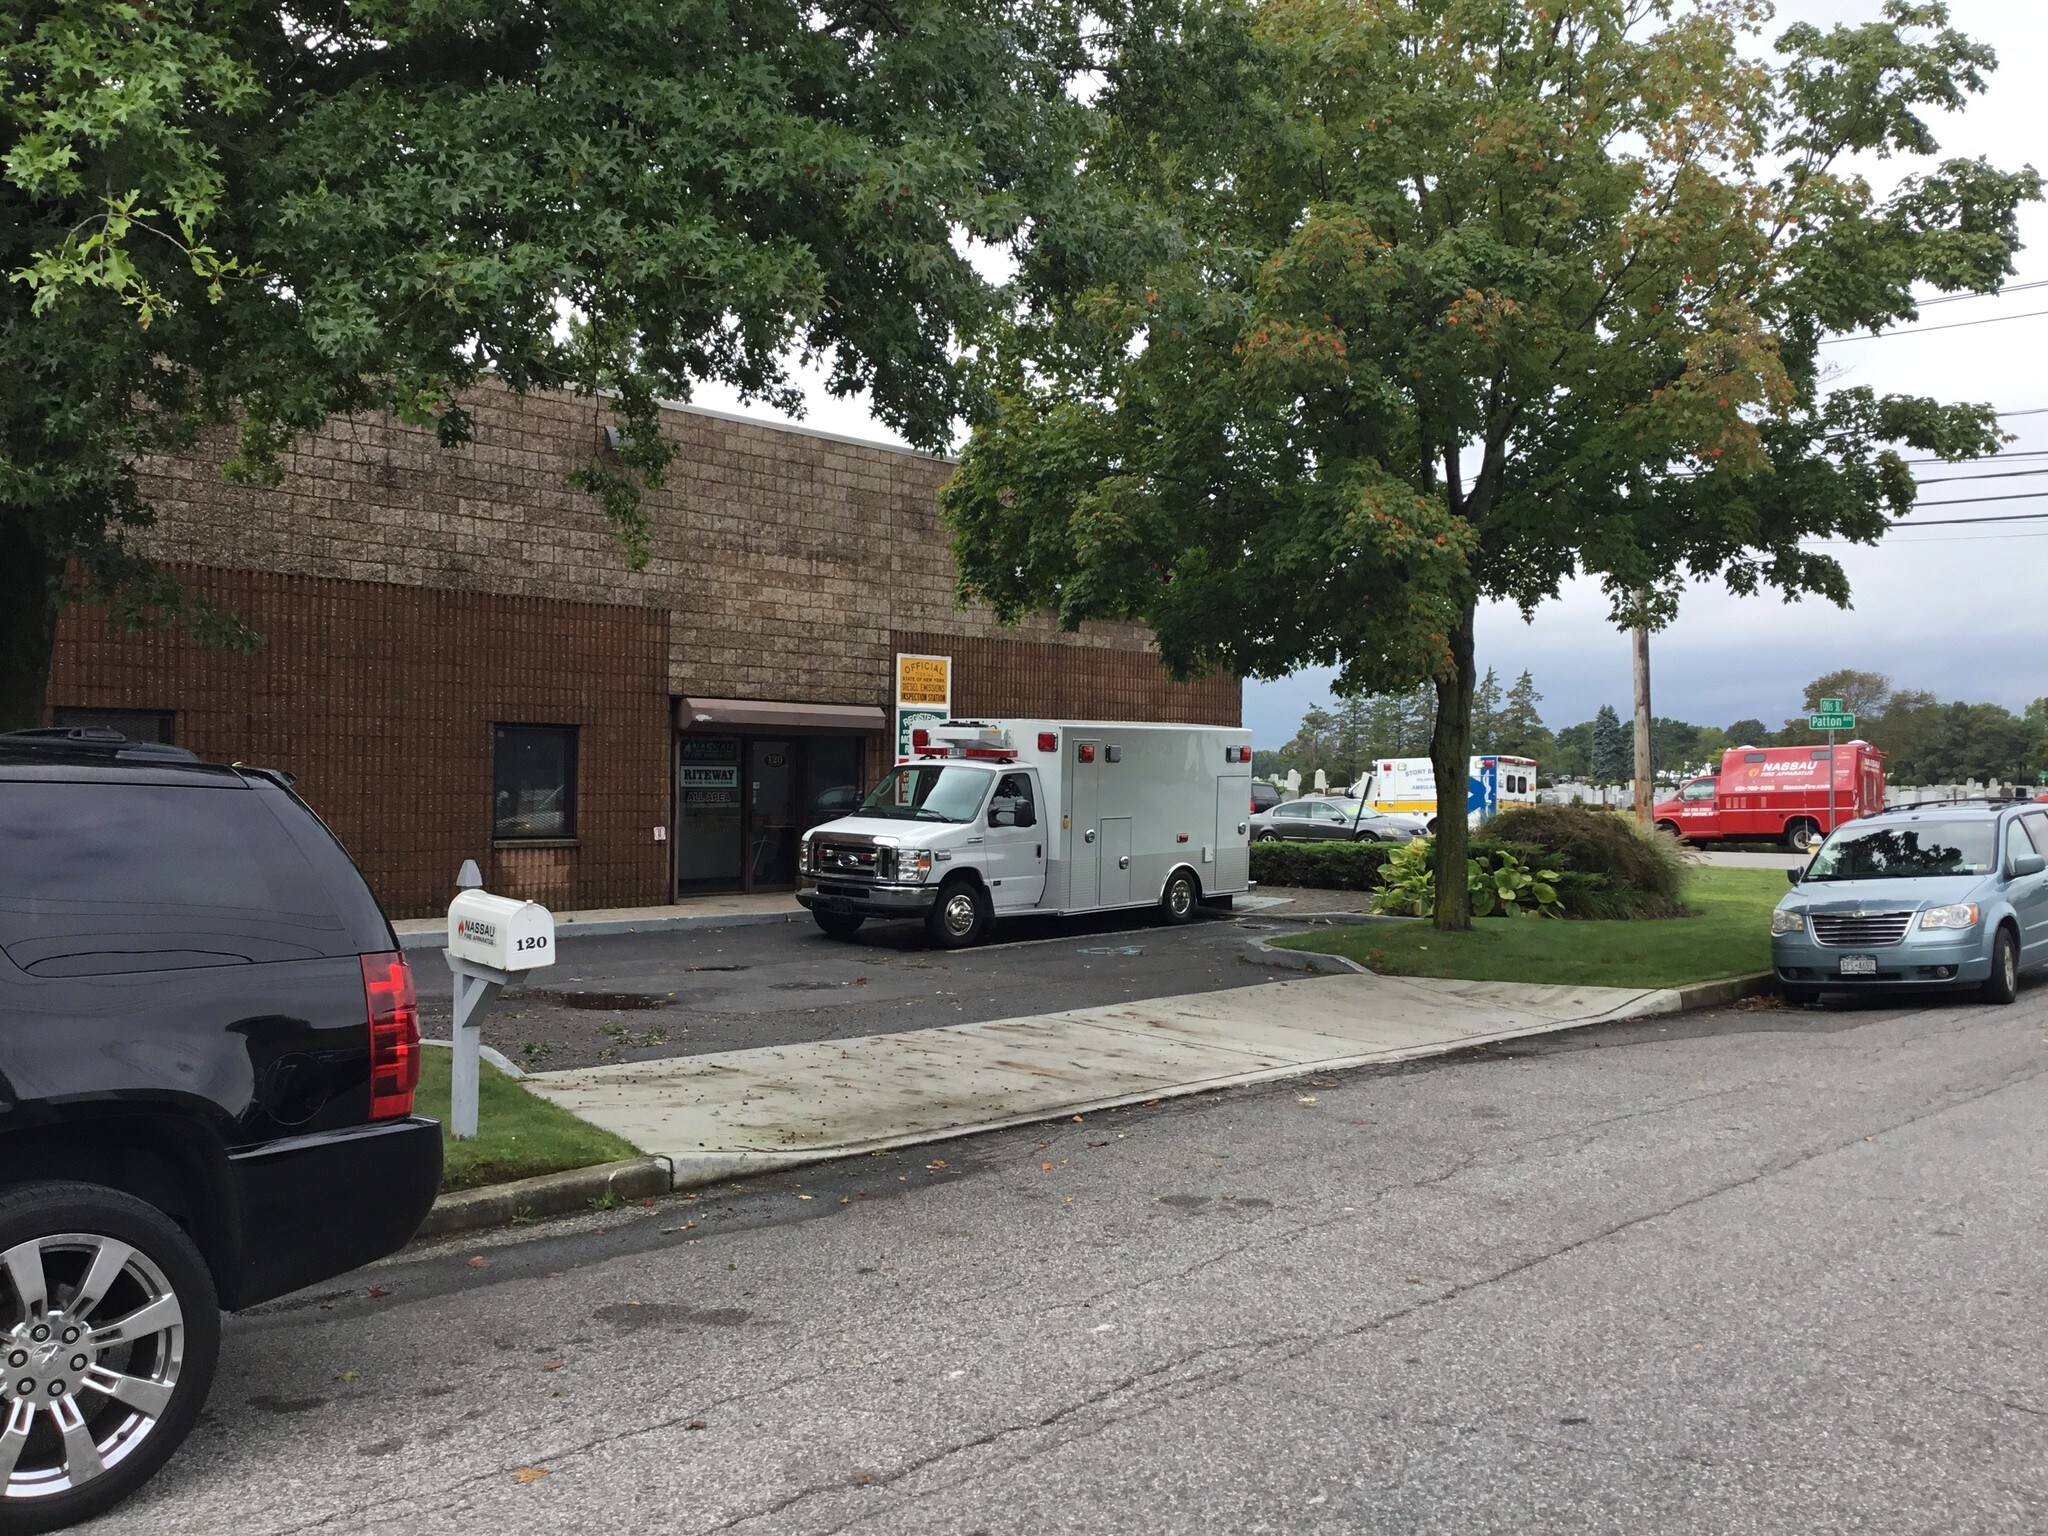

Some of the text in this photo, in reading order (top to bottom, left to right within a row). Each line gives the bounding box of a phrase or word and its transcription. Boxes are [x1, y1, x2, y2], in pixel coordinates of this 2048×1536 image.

[904, 661, 944, 676] OFFICIAL
[902, 683, 945, 693] DIESEL EMISSIONS
[902, 692, 946, 702] INSPECTION STATION
[1822, 700, 1834, 712] Otis
[1812, 715, 1842, 727] Patton
[768, 754, 783, 764] 120
[1762, 761, 1818, 772] NASSAU
[684, 769, 735, 780] RITEWAY
[1405, 769, 1426, 777] STONY
[687, 792, 731, 802] ALL AREA
[465, 920, 495, 937] NASSAU
[472, 935, 494, 946] APPARATUS
[516, 936, 547, 951] 120
